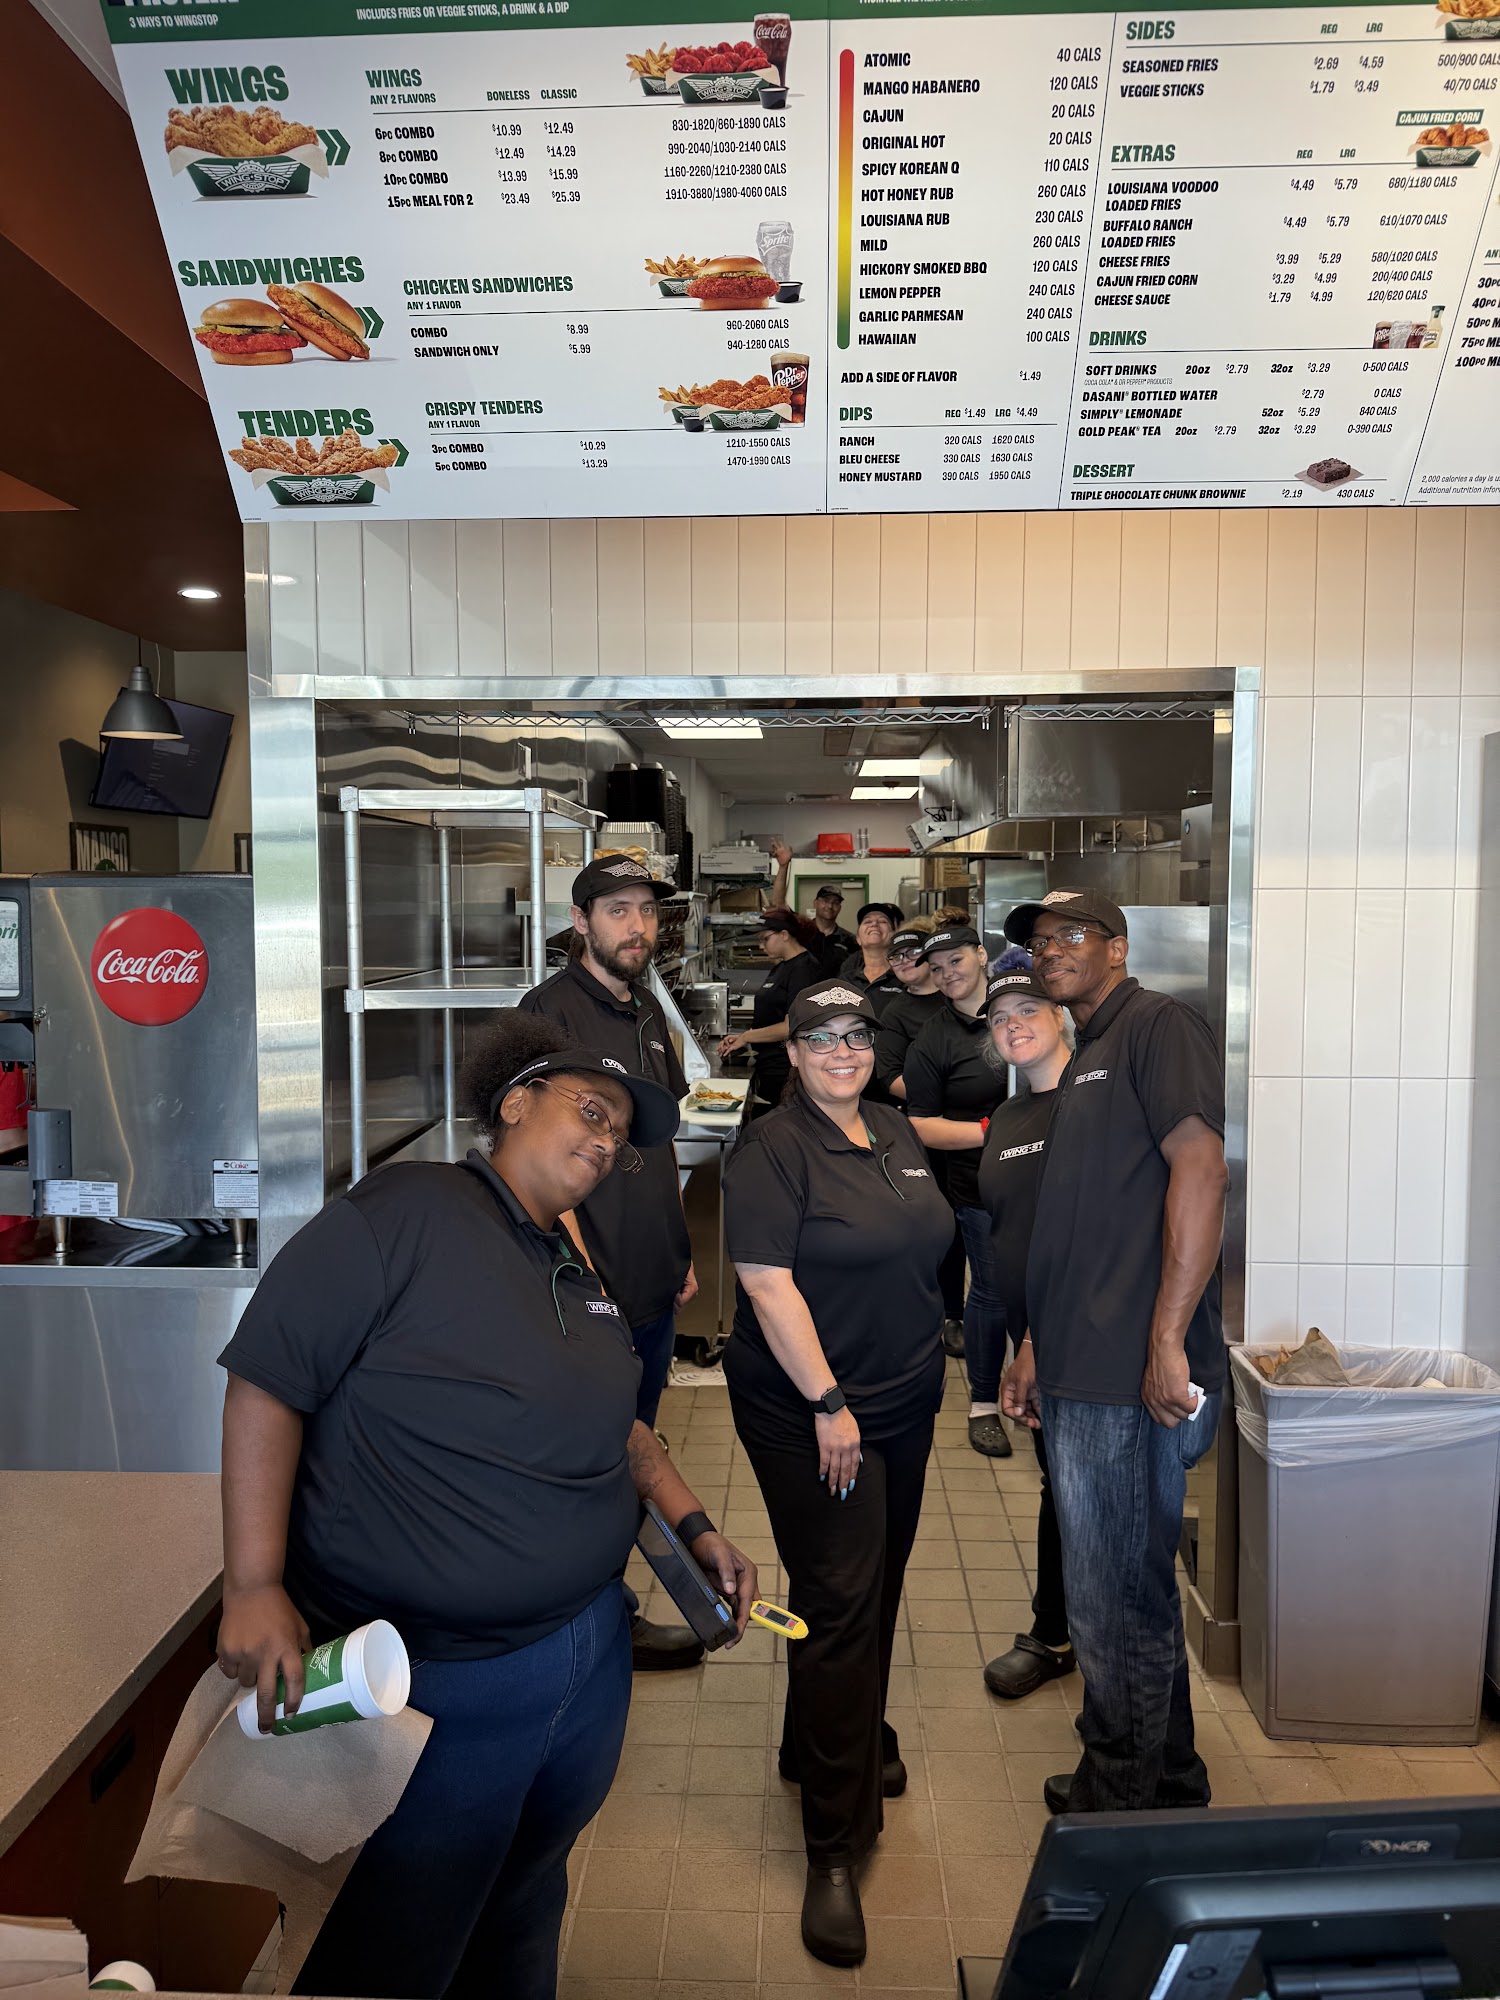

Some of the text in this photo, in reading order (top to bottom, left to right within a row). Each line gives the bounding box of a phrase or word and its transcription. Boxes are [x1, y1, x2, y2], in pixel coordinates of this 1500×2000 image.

[357, 2, 569, 20] INCLUDES FRIES OR VEGGIE STICKS, DRINK DIP
[129, 14, 218, 28] 3 WAYS TO WINGSTOP
[1126, 21, 1175, 40] SIDES
[1321, 23, 1383, 33] REG LRG
[864, 47, 1101, 67] ATOMIC 40 CALS
[1315, 54, 1477, 69] $2.69 $4.59 500/900
[1123, 59, 1218, 73] SEASONED FRIES
[164, 65, 289, 104] WINGS
[365, 69, 422, 88] WINGS
[864, 77, 1067, 95] MANGO HABANERO 120
[1121, 84, 1204, 97] VEGGIE STICKS
[1311, 79, 1471, 94] $1.79 $3.49 40/70
[371, 93, 436, 104] ANY FLAVORS
[487, 89, 577, 101] BONELESS CLASSIC
[863, 109, 903, 122] CAJUN
[1400, 112, 1480, 123] CAJUN FRIED CORN
[395, 126, 434, 139] COMBO
[492, 124, 521, 136] $10.99
[544, 122, 573, 133] $12.49
[673, 117, 785, 132] 830-1820/860-1890 CALS
[863, 135, 945, 149] ORIGINAL HOT
[1111, 144, 1175, 162] EXTRAS
[862, 162, 947, 175] SPICY KOREAN
[1108, 181, 1218, 194] LOUISIANA VOODOO
[1291, 176, 1432, 191] $4.49 $5.79 680/1180
[413, 195, 442, 206] MEAL
[444, 195, 464, 206] FOR
[862, 188, 953, 201] HOT HONEY RUB
[1106, 199, 1181, 211] LOADED FRIES
[861, 211, 1054, 226] LOUISIANA RUB 230
[1103, 219, 1193, 231] BUFFALO RANCH
[861, 240, 887, 251] MILD
[1099, 256, 1170, 267] CHEESE FRIES
[178, 256, 364, 287] SANDWICHES
[860, 262, 987, 275] HICKORY SMOKED BBQ
[404, 276, 573, 295] CHICKEN SANDWICHES
[860, 287, 940, 299] LEMON PEPPER
[1095, 294, 1170, 305] CHEESE SAUCE
[859, 310, 963, 322] GARLIC PARMESAN
[411, 324, 588, 338] COMBO $8.99
[727, 319, 789, 330] 960-2060 CALS
[859, 334, 916, 345] HAWAIIAN
[1089, 331, 1146, 345] DRINKS
[414, 346, 499, 357] SANDWICH ONLY
[1086, 364, 1248, 375] SOFT DRINKS 20oz $2.79
[1271, 362, 1386, 373] 32oz $3.29 0-500
[841, 371, 1041, 383] ADD SIDE OF FLAVOR $1.49
[1131, 391, 1176, 401] BOTTLED
[1180, 390, 1217, 400] WATER
[426, 400, 543, 416] CRISPY TENDERS
[840, 407, 872, 421] DIPS
[965, 408, 985, 417] $1.49
[995, 409, 1010, 417] LRG
[1017, 407, 1037, 416] $4.49
[1125, 409, 1182, 418] LEMONADE
[1262, 407, 1375, 417] 52oz $5.29 840
[238, 409, 374, 438] TENDERS
[1079, 427, 1105, 436] GOLD
[1143, 426, 1161, 435] TEA
[580, 441, 605, 450] $10.29
[727, 438, 768, 447] 1210-1550
[840, 435, 1012, 446] RANCH 320 1620
[840, 455, 900, 464] BLEU CHEESE
[840, 472, 921, 482] HONEY MUSTARD
[1073, 464, 1135, 477] DESSERT
[1071, 489, 1246, 500] TRIPLE CHOCOLATE CHUNK BROWNIE
[75, 829, 128, 871] MANGO
[98, 948, 205, 983] Coca-Cola
